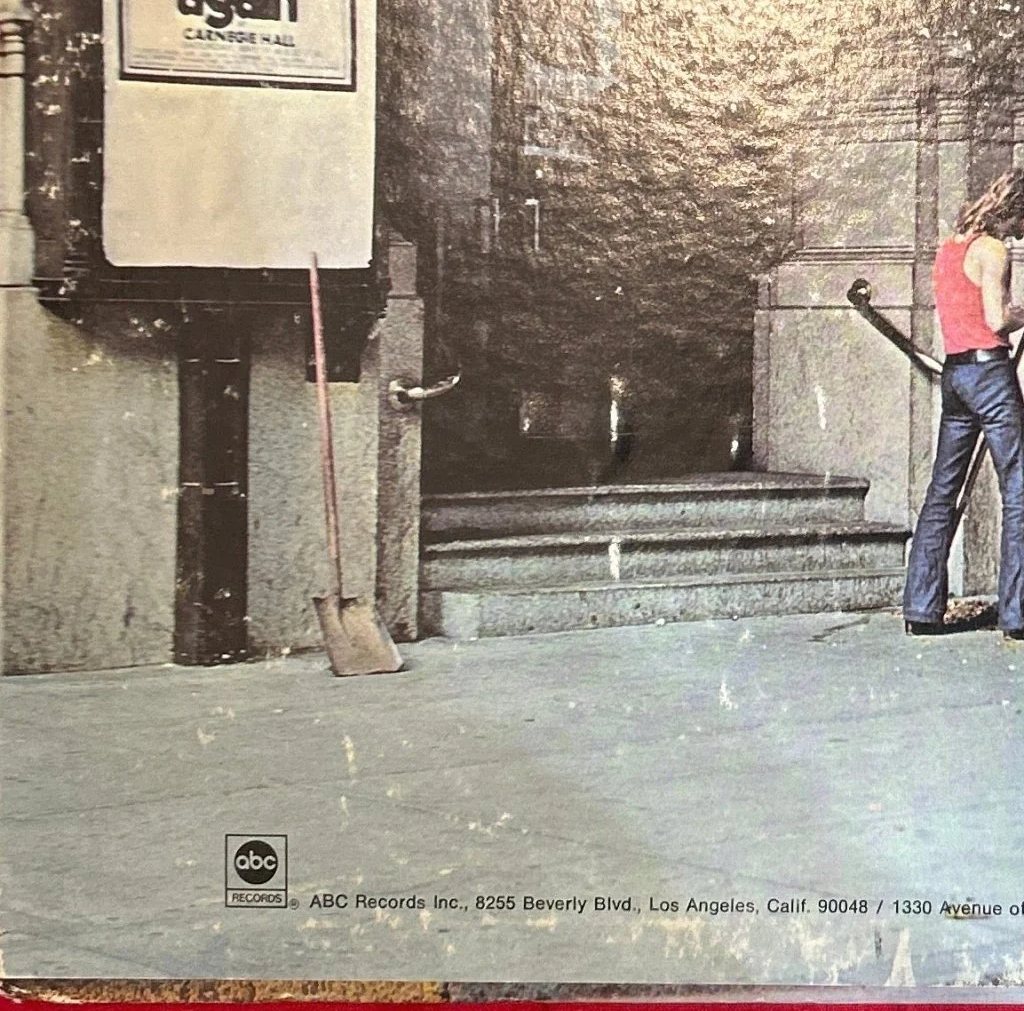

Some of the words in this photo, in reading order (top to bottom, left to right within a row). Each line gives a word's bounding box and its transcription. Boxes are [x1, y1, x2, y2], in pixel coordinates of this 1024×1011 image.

[236, 850, 278, 870] abc
[232, 893, 283, 904] RECORDS
[309, 894, 348, 910] ABC
[356, 895, 425, 911] Records
[434, 895, 468, 913] Inc.,
[476, 896, 515, 911] 8255
[524, 896, 587, 915] Beverly
[595, 897, 641, 915] Blvd.,
[650, 897, 679, 913] Los
[686, 898, 759, 917] Angeles,
[767, 899, 810, 914] Calif.
[818, 899, 868, 914] 90048
[893, 900, 932, 915] 1330
[940, 900, 1002, 916] Avenue
